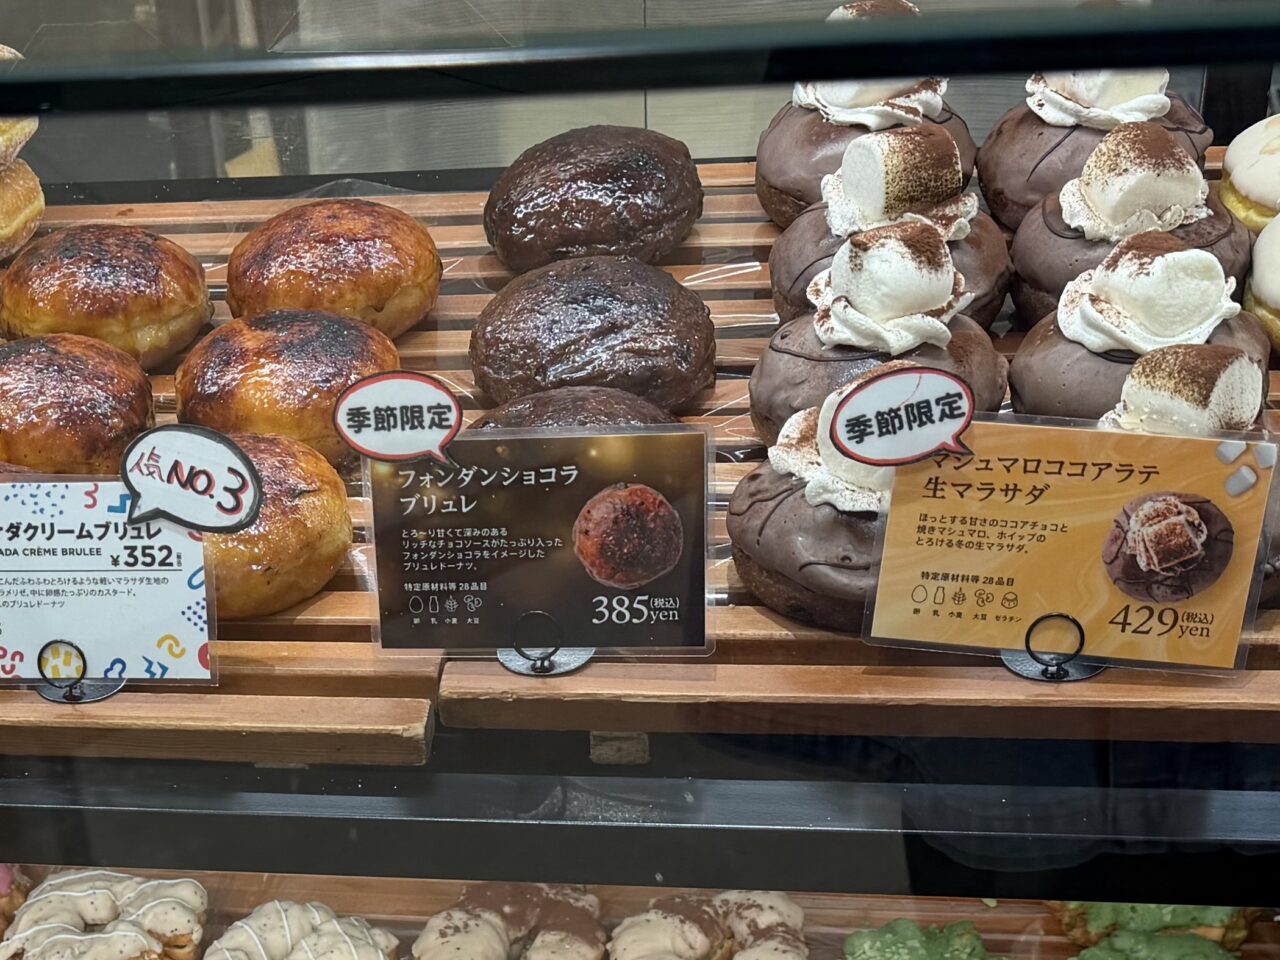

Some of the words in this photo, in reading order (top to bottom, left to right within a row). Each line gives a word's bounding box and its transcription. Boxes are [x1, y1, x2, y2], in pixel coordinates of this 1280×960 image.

[345, 402, 454, 433] 季節限定
[845, 391, 967, 446] 季節限定
[398, 464, 579, 489] フォンダンショコラ
[932, 453, 1160, 485] マシュマロココアラテ
[922, 476, 1051, 505] 生マラサダ
[399, 495, 478, 516] ブリュレ
[916, 525, 1046, 543] 焼きマシュマロ、ホイップの
[919, 513, 1069, 534] ほっとする甘さのココアチョコと
[22, 546, 58, 557] CRÈME
[61, 547, 102, 556] BRULEE
[110, 545, 174, 568] ¥352
[403, 549, 545, 560] フォンダンショコラをイメージした
[915, 537, 1029, 554] とろける冬の生マラサダ。
[592, 595, 650, 625] 385
[649, 609, 679, 624] yen
[1108, 604, 1179, 636] 429
[1178, 625, 1210, 638] yen
